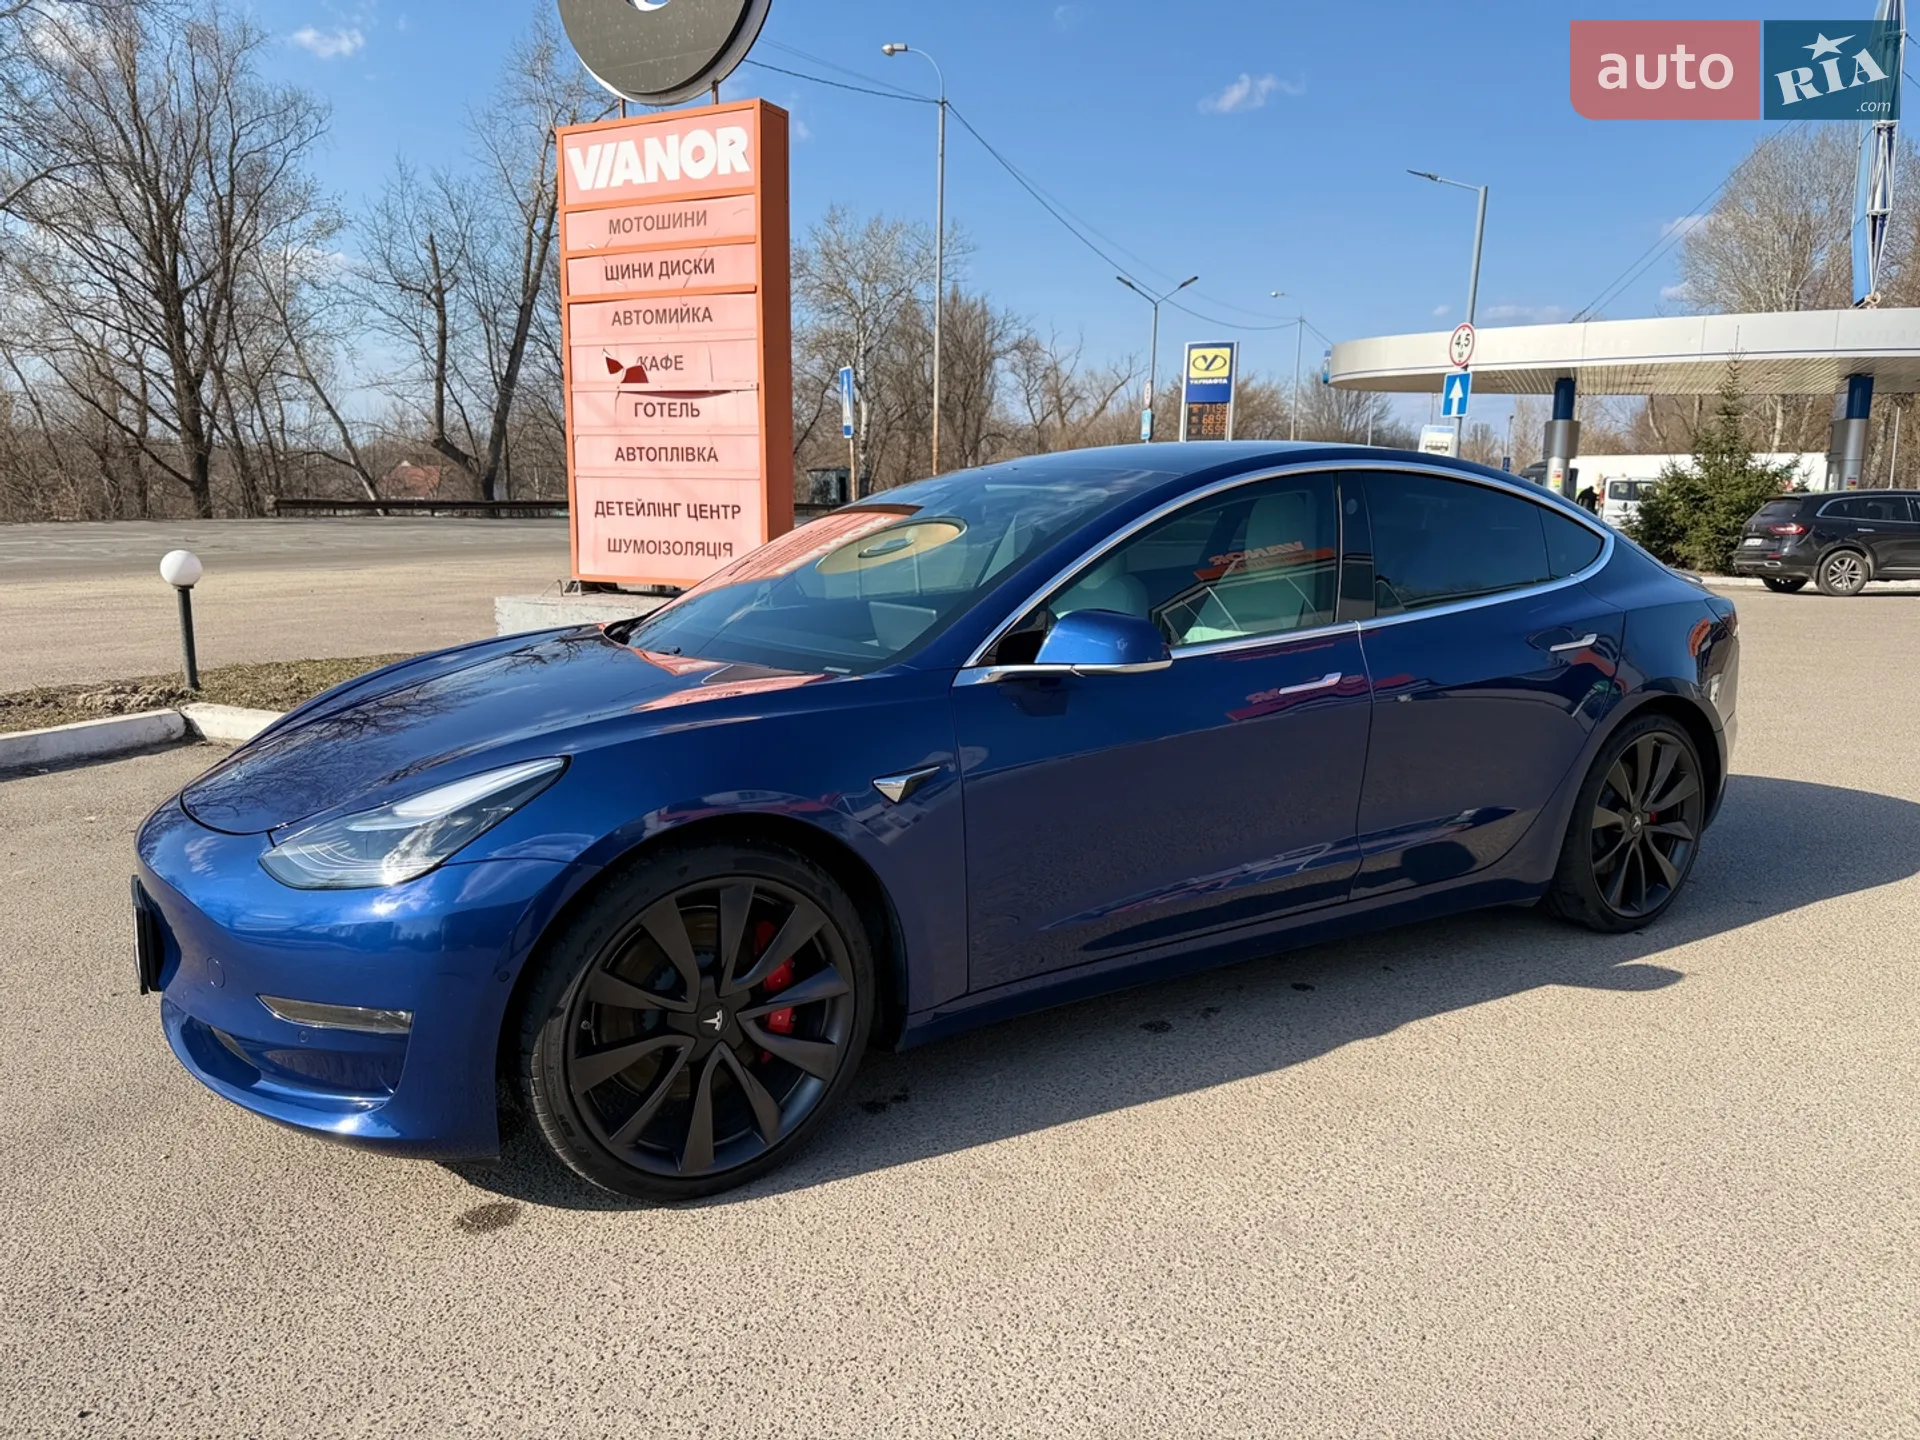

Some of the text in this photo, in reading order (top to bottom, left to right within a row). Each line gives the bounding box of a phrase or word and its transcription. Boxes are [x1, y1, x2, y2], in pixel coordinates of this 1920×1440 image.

[567, 126, 750, 191] VIANOR
[608, 210, 707, 235] МОТОШИНИ
[604, 258, 715, 281] ШИНИ ДИСКИ
[611, 303, 713, 326] АВТОМИЙКА
[636, 354, 684, 371] КАФЕ
[634, 402, 700, 418] ГОТЕЛЬ
[614, 446, 719, 463] АВТОПЛІВКА
[594, 498, 742, 521] ДЕТЕЙЛІНГ ЦЕНТР
[607, 538, 733, 560] ШУМОІЗОЛЯЦІЯ
